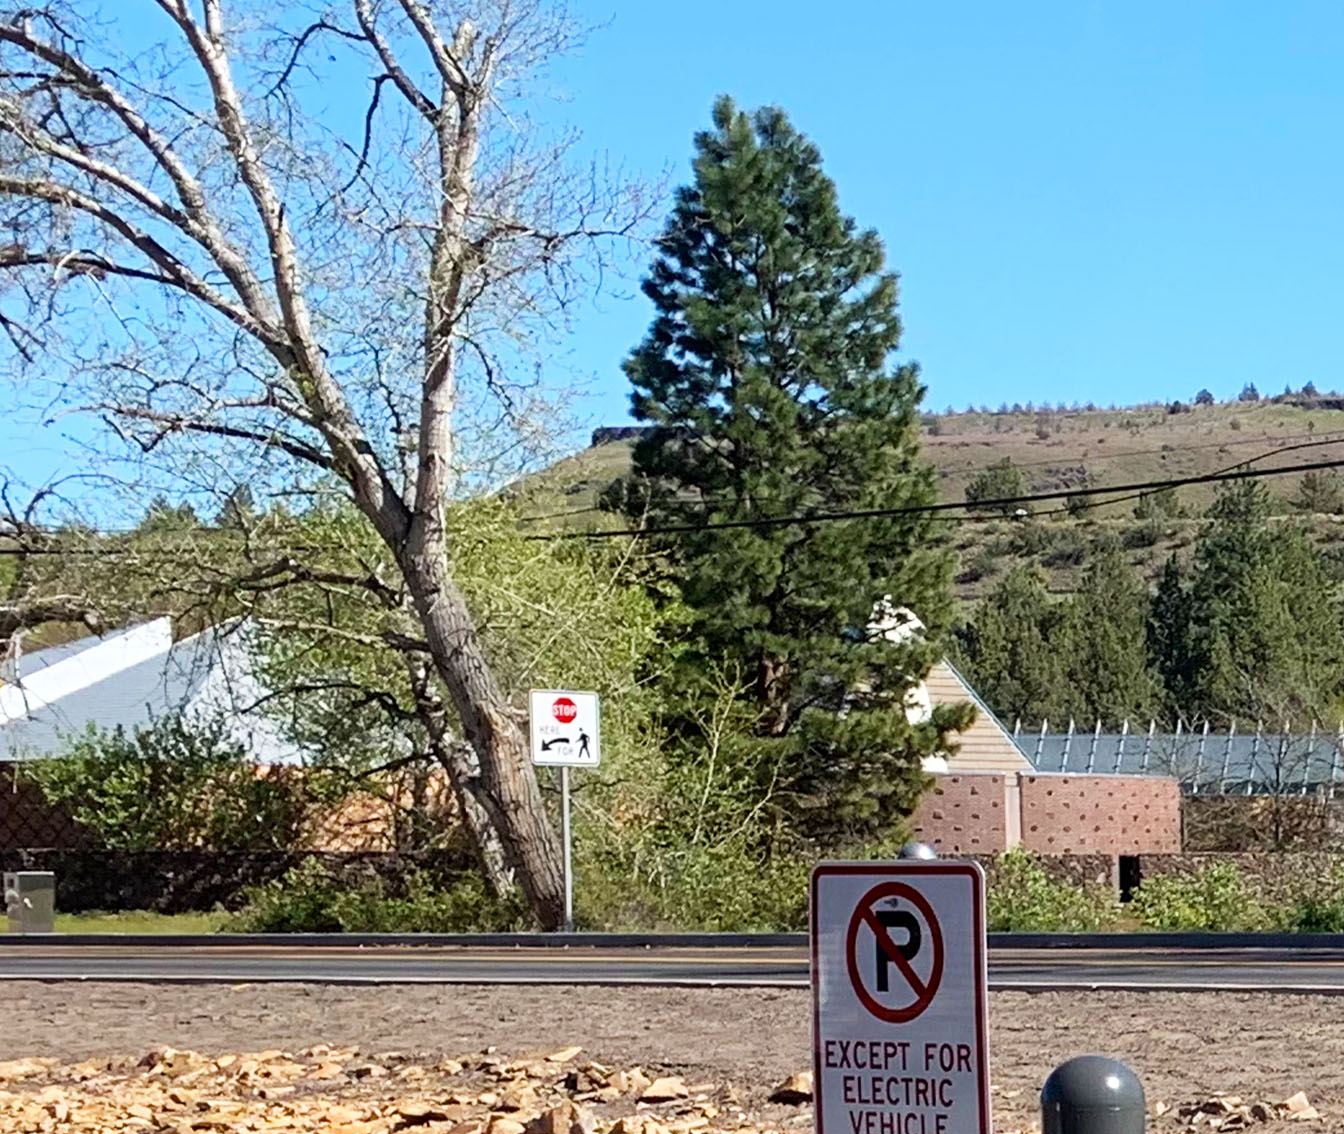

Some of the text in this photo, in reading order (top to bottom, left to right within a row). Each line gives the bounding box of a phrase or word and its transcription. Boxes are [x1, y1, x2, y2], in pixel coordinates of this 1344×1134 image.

[552, 704, 577, 717] STOP
[824, 1040, 972, 1072] EXCEPT FOR
[843, 1075, 954, 1107] ELECTRIC
